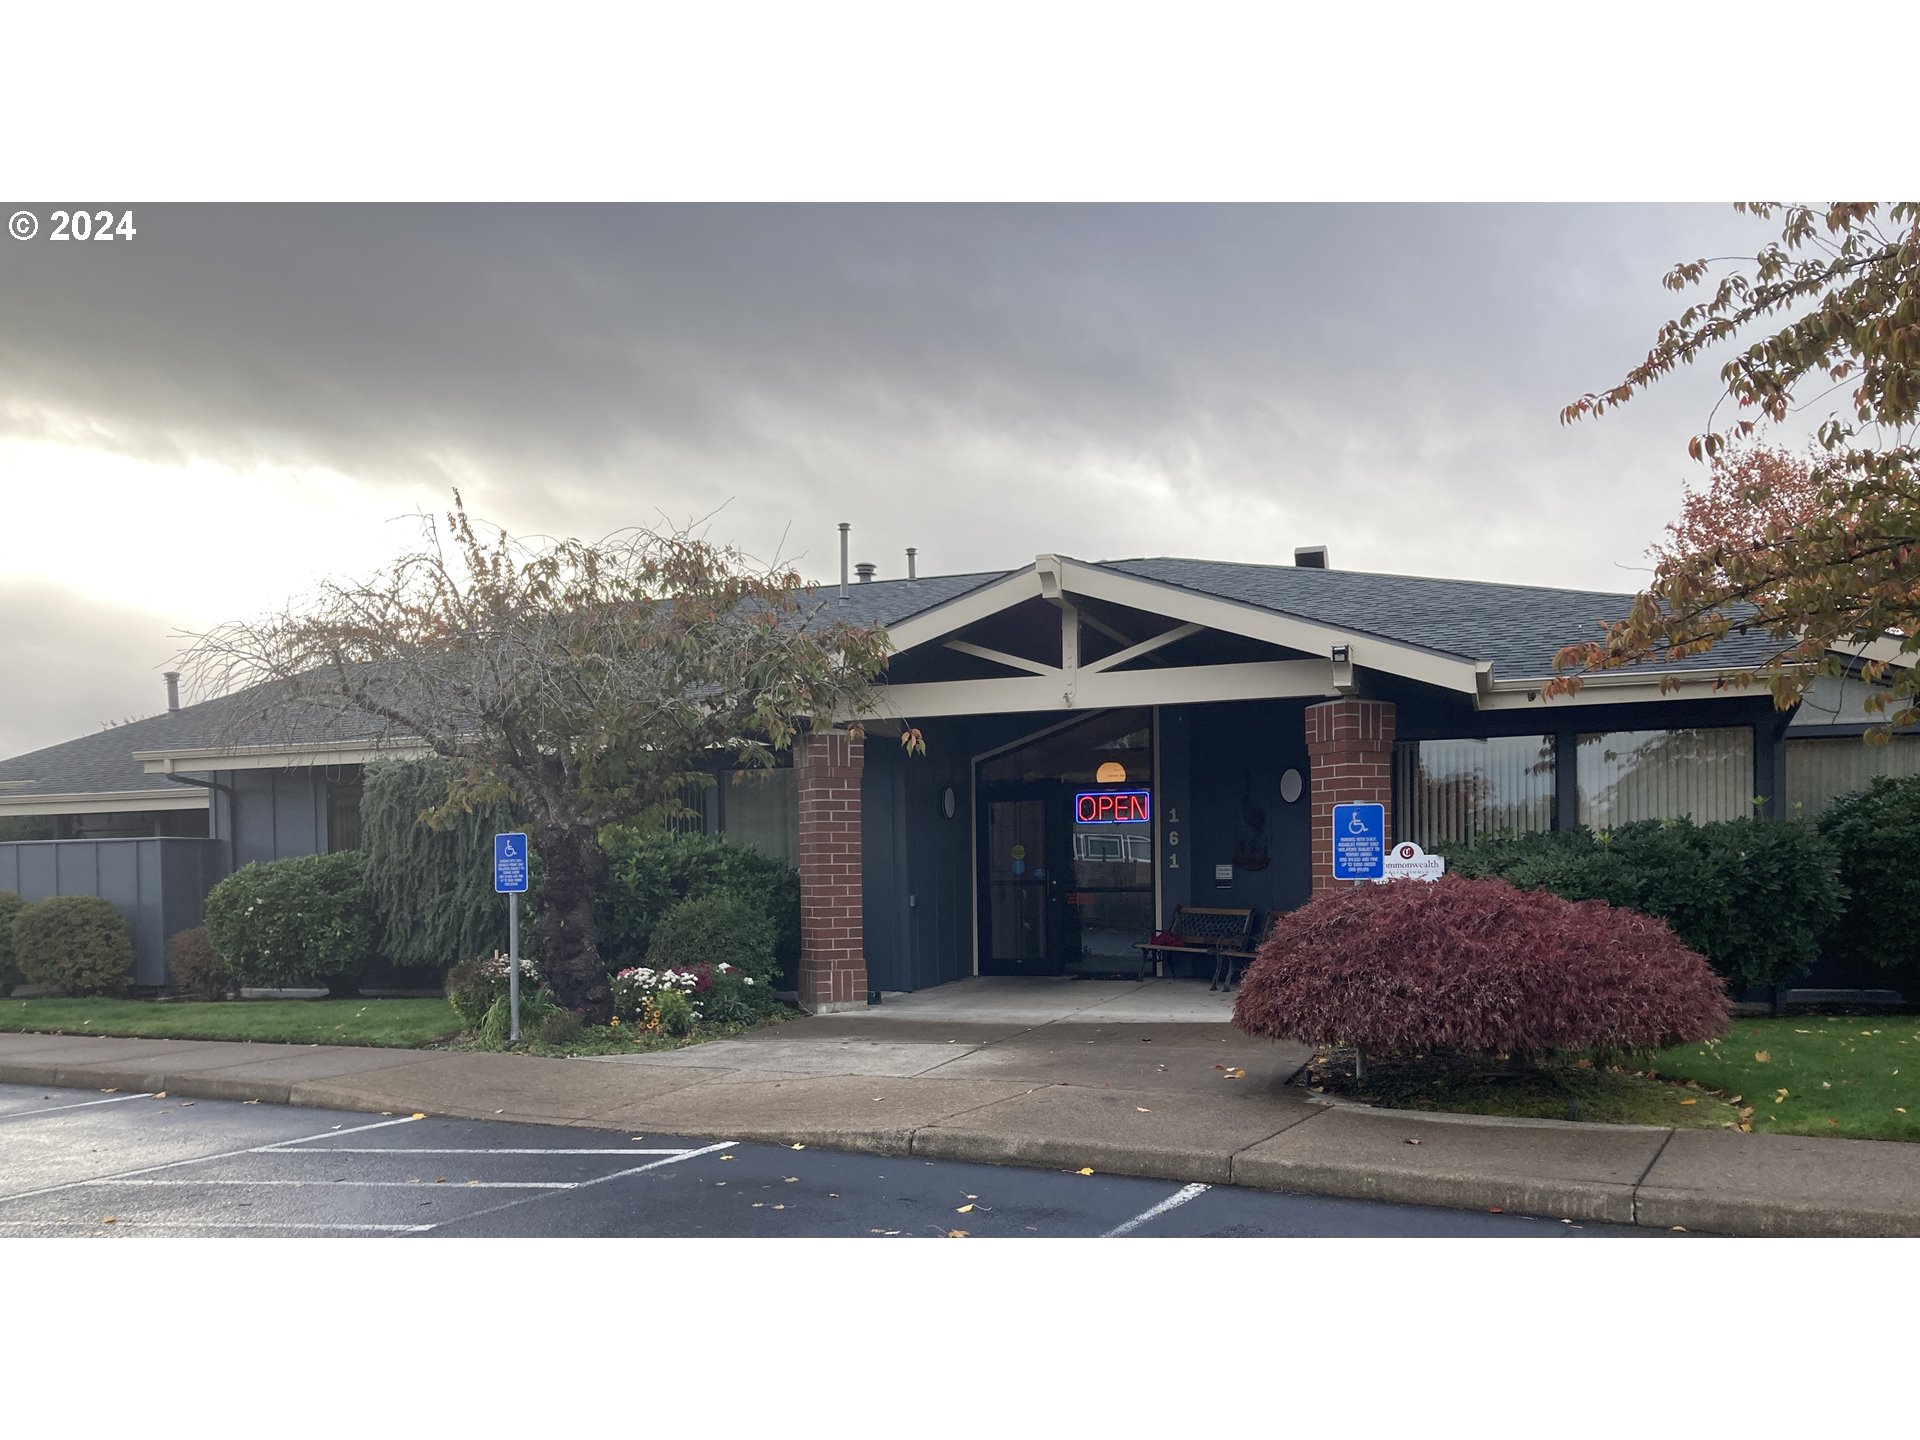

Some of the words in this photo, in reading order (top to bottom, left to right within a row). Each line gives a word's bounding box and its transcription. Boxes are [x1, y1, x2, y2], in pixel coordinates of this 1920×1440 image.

[1078, 795, 1148, 822] OPEN
[1169, 808, 1179, 868] 161
[1385, 860, 1439, 869] ommonwealth
